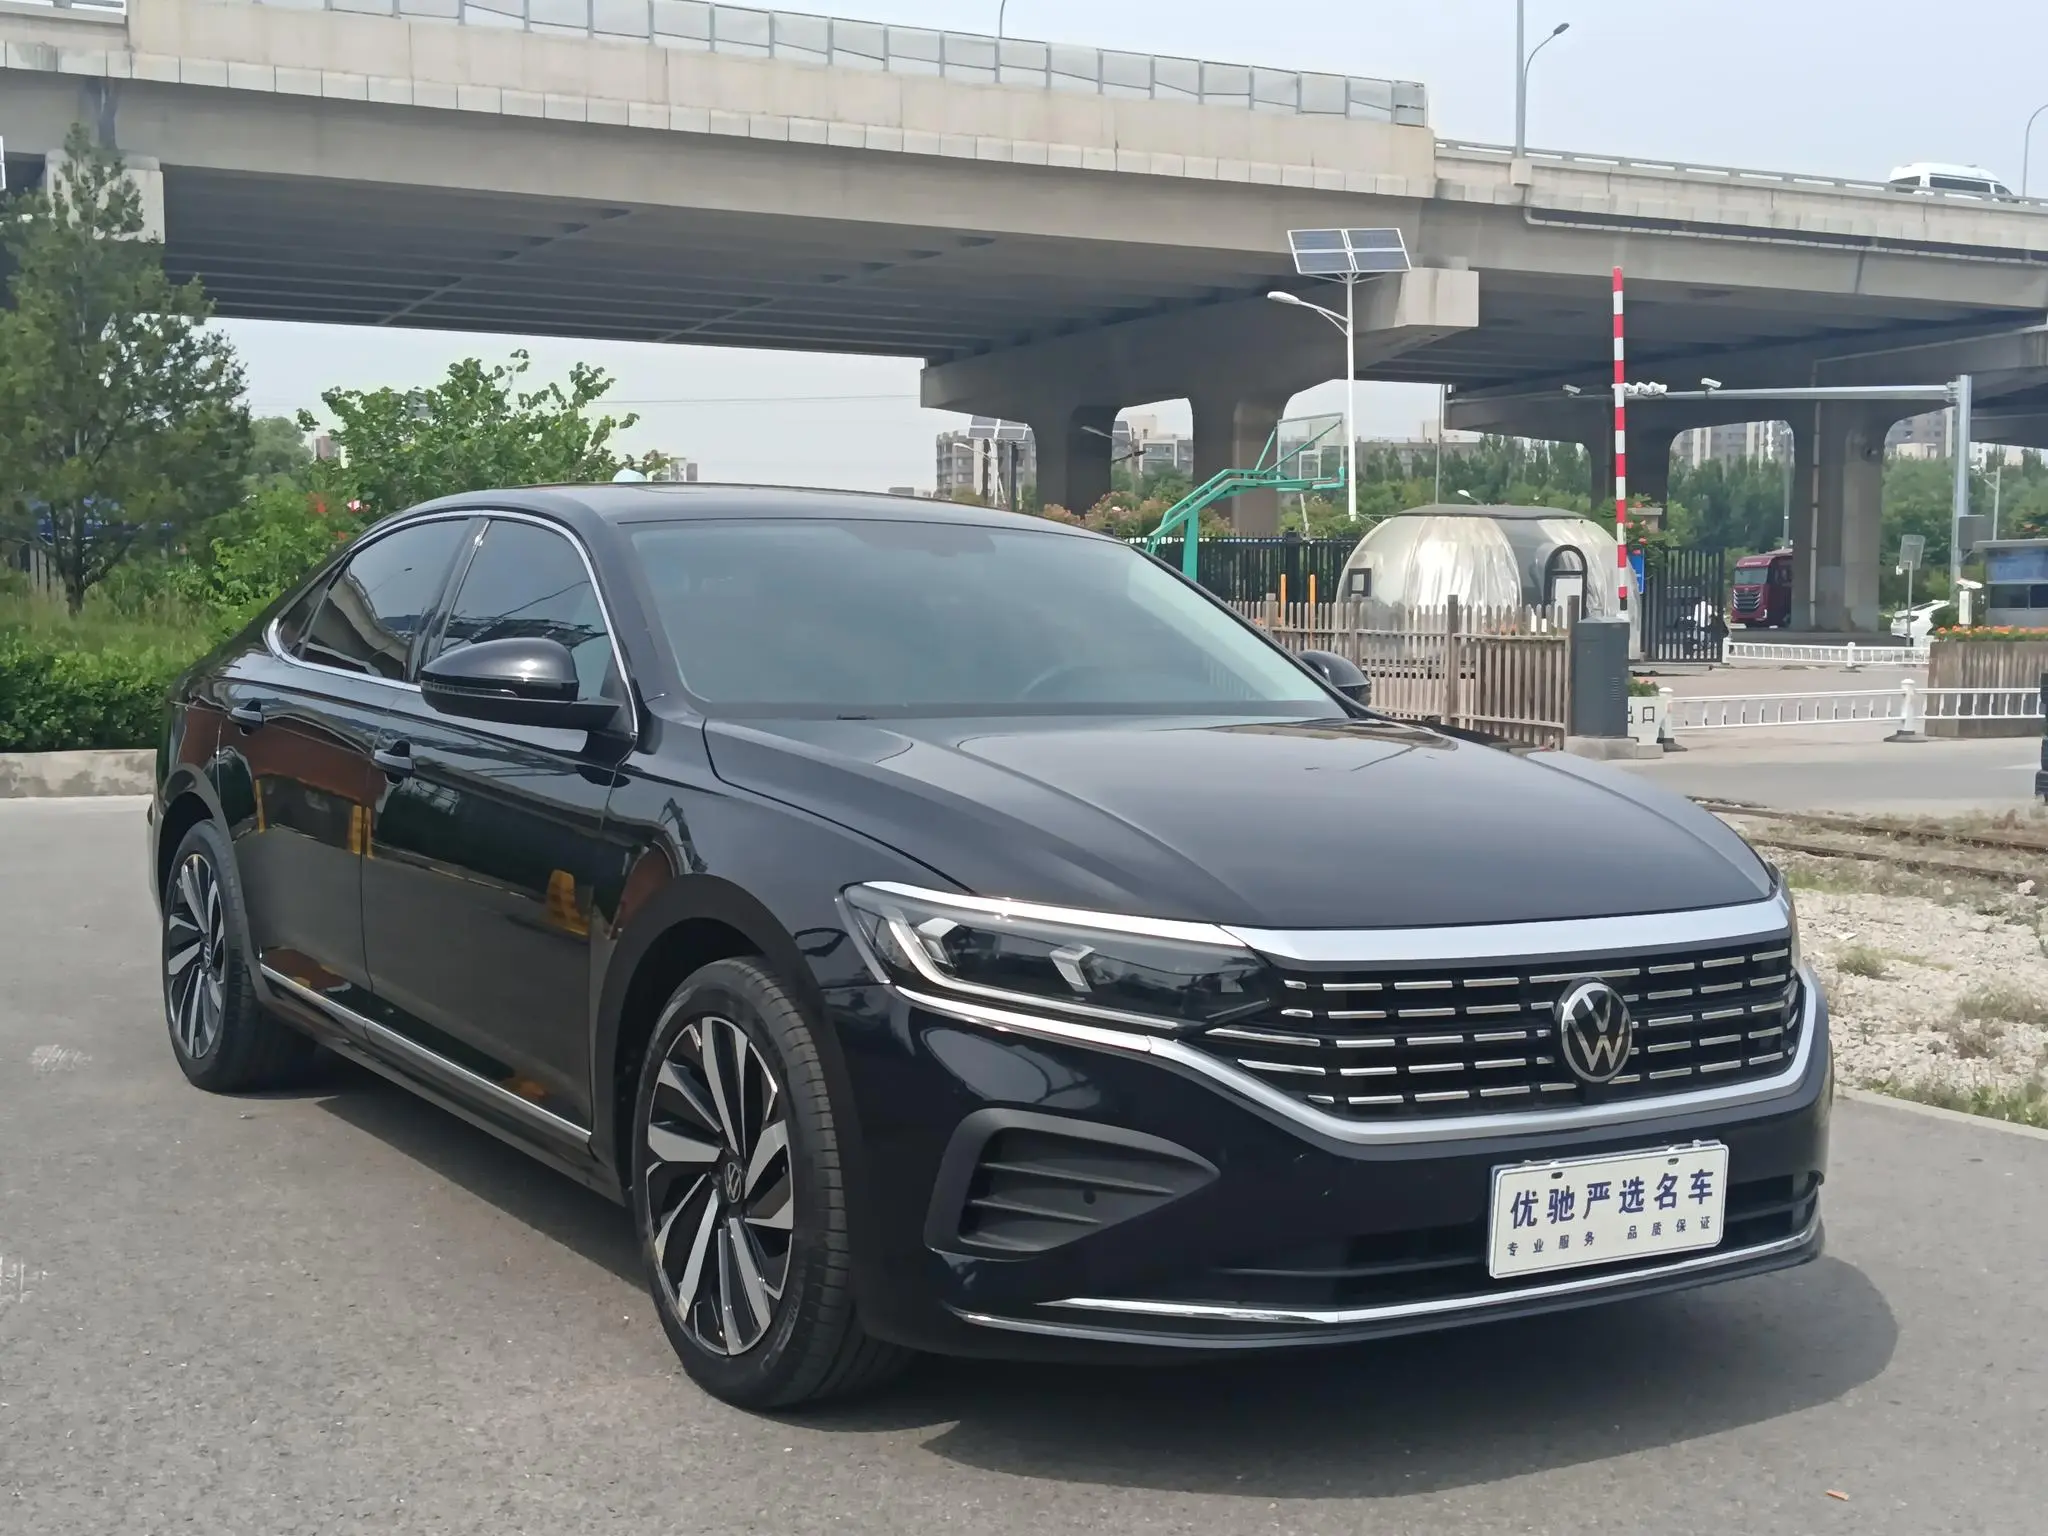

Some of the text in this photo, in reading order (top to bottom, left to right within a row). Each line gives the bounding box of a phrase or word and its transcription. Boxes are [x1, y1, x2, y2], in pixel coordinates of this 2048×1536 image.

[1562, 982, 1632, 1082] VW
[1510, 1168, 1714, 1229] 优驰严选名车
[1507, 1215, 1711, 1257] 专业服务 品质保证
